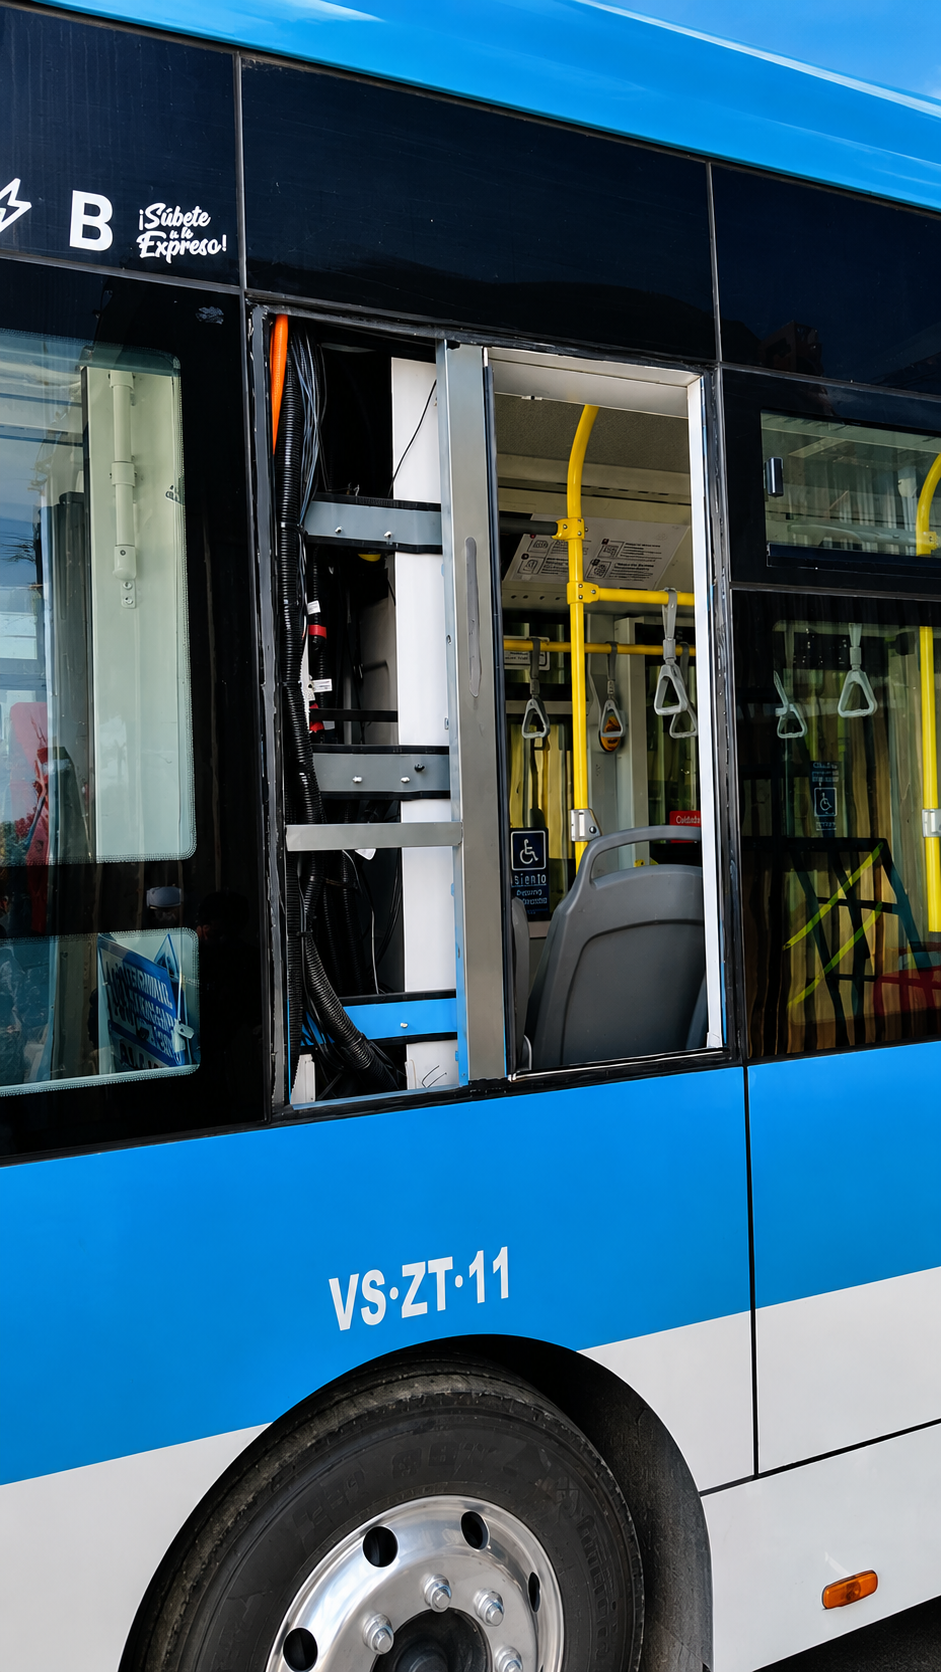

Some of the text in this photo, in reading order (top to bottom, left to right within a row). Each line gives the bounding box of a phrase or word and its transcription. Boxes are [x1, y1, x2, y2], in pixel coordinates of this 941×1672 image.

[69, 189, 114, 252] B
[138, 202, 211, 231] ¡Súbete
[135, 230, 227, 264] Expreso!
